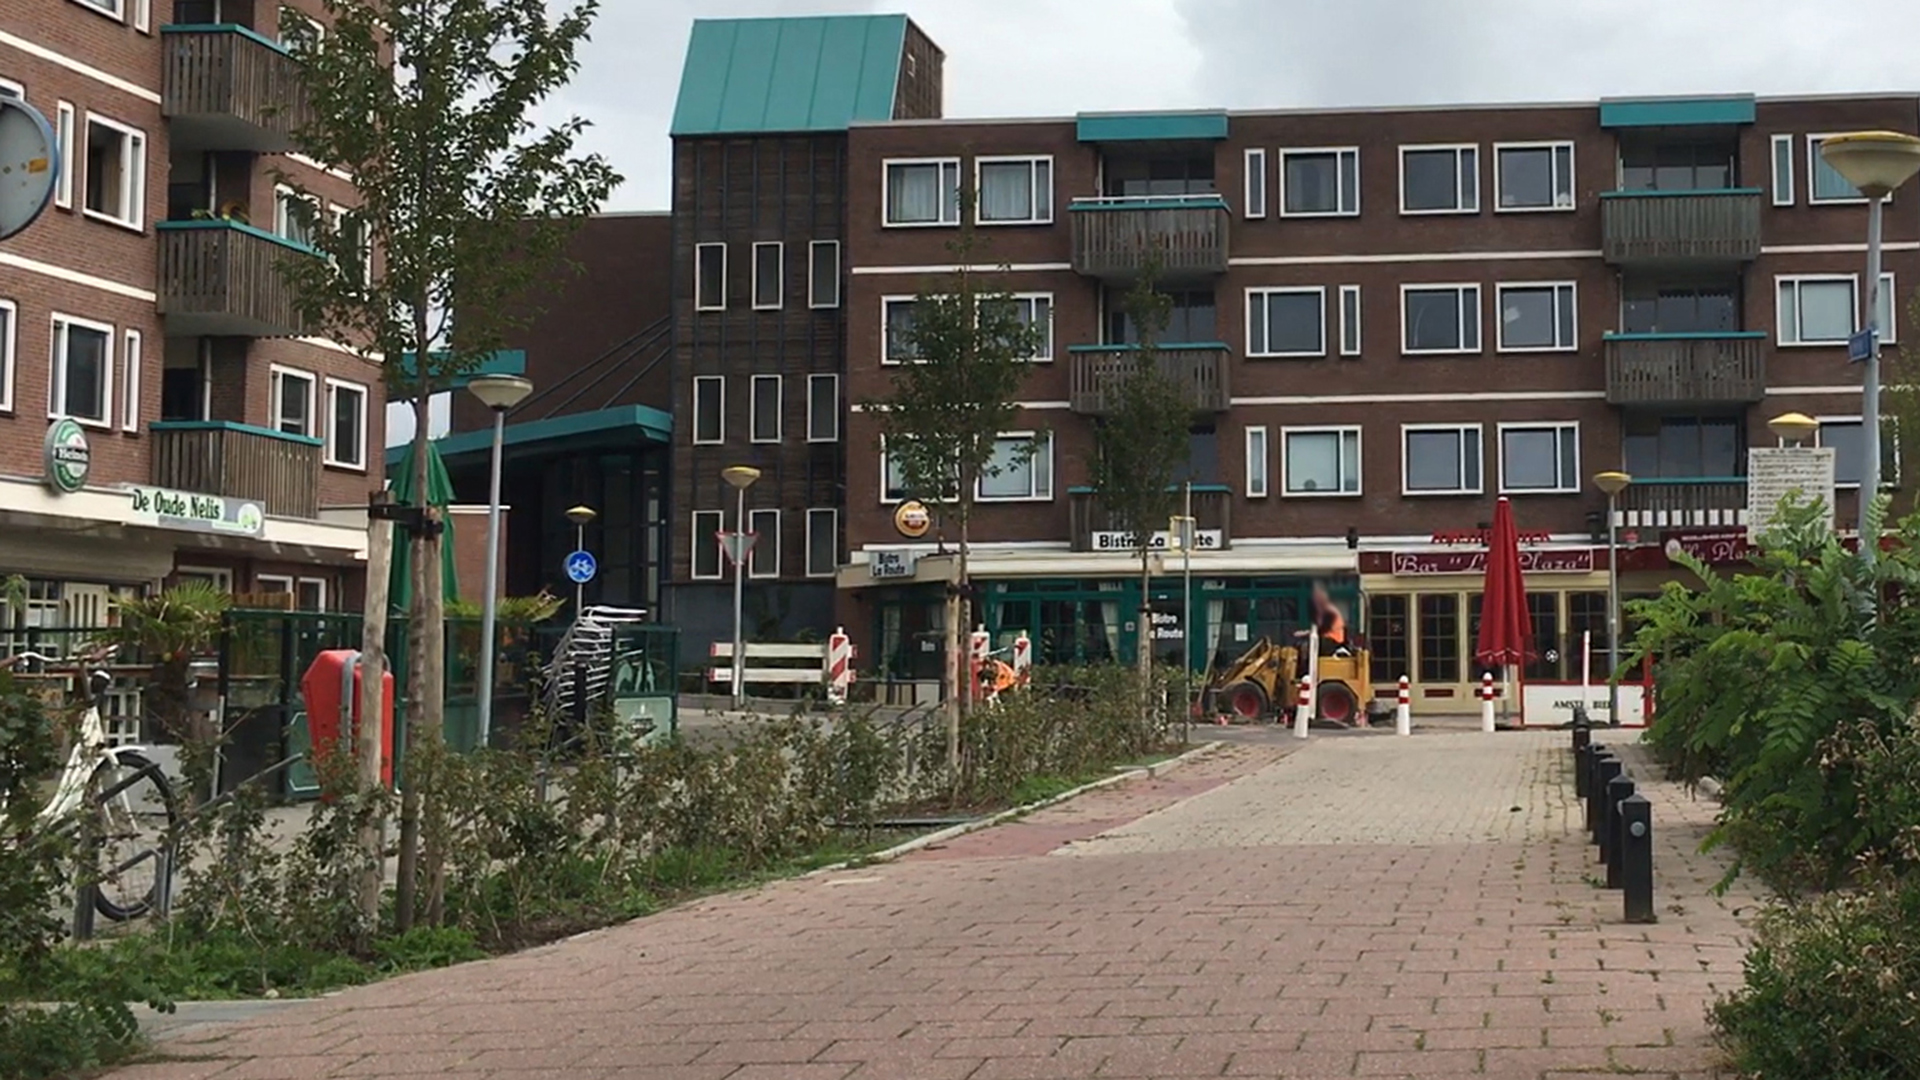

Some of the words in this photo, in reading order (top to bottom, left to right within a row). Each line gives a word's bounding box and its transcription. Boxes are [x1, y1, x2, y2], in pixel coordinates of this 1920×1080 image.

[132, 489, 150, 512] De
[154, 491, 187, 516] Oude
[190, 496, 220, 520] Nelis
[1099, 534, 1138, 548] Bistr
[1396, 554, 1438, 572] Bar
